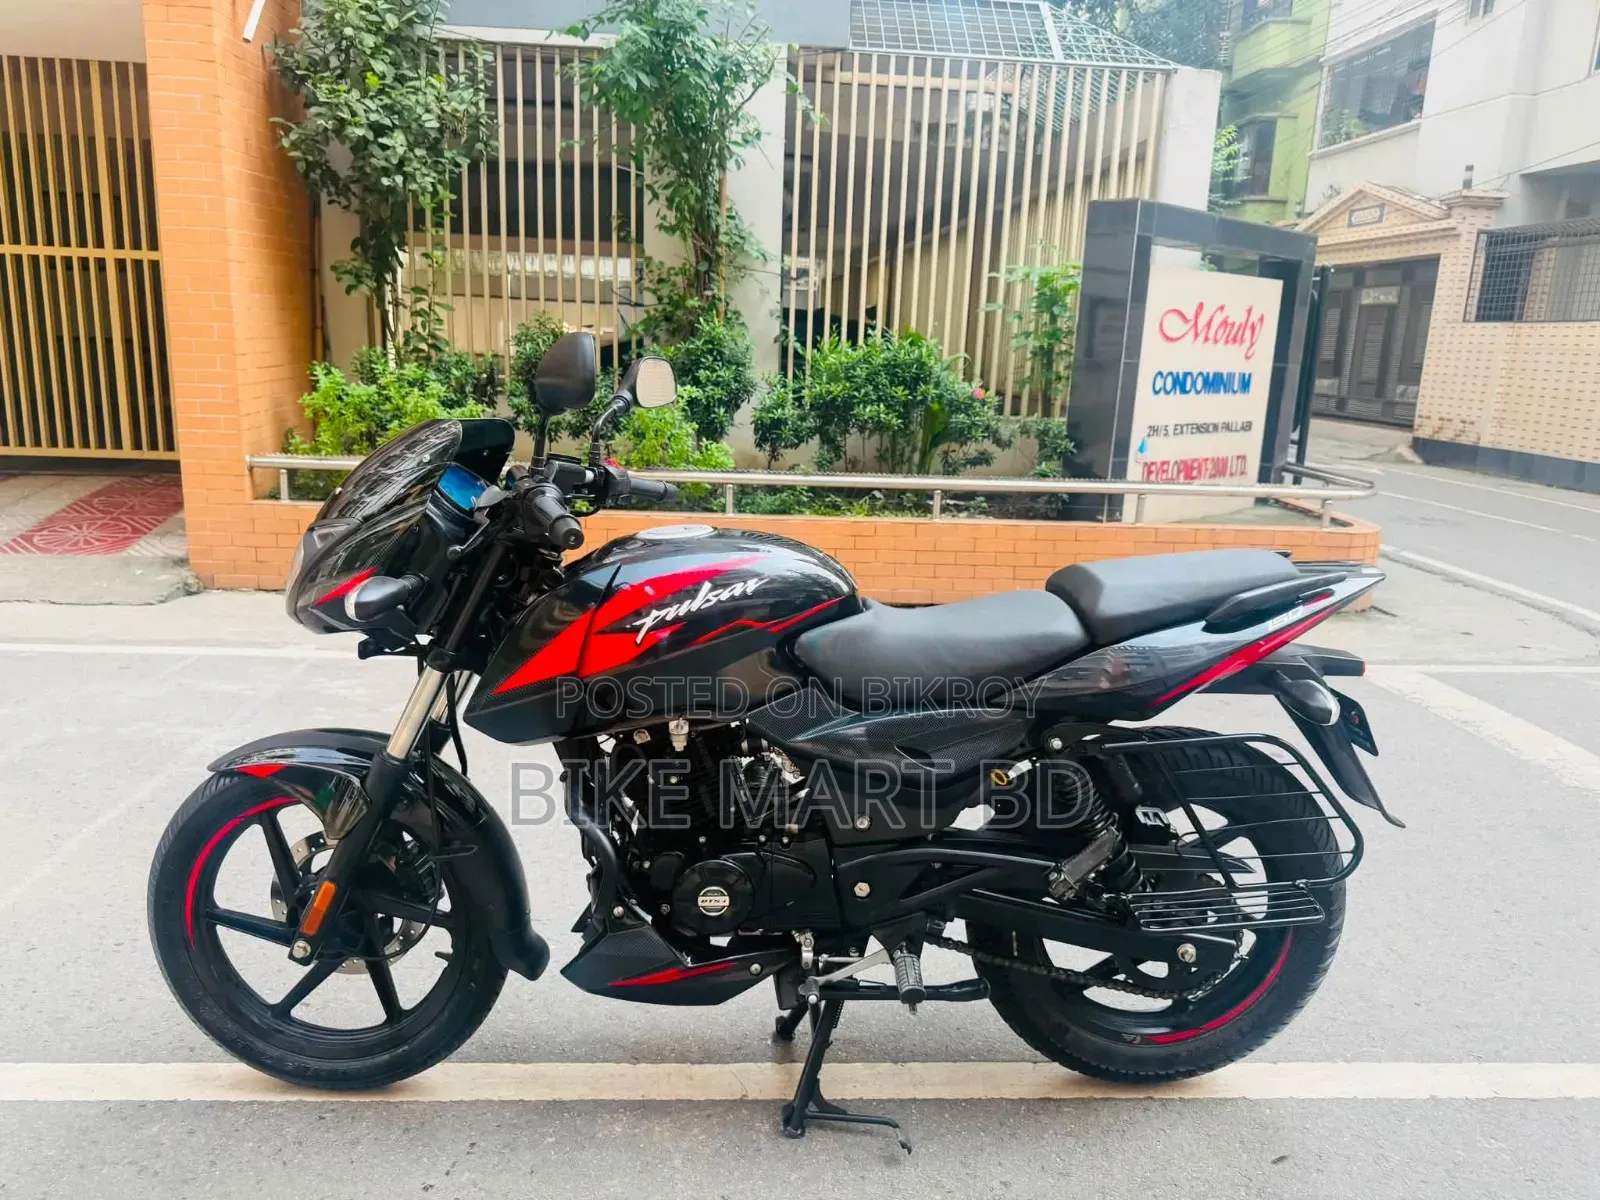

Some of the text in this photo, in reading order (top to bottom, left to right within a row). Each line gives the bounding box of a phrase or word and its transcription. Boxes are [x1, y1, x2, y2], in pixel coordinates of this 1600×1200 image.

[1158, 301, 1265, 361] Mouly
[1152, 370, 1252, 396] CONDOMINIUM
[1173, 422, 1219, 436] EXTENSION
[1220, 420, 1253, 433] PALLABI
